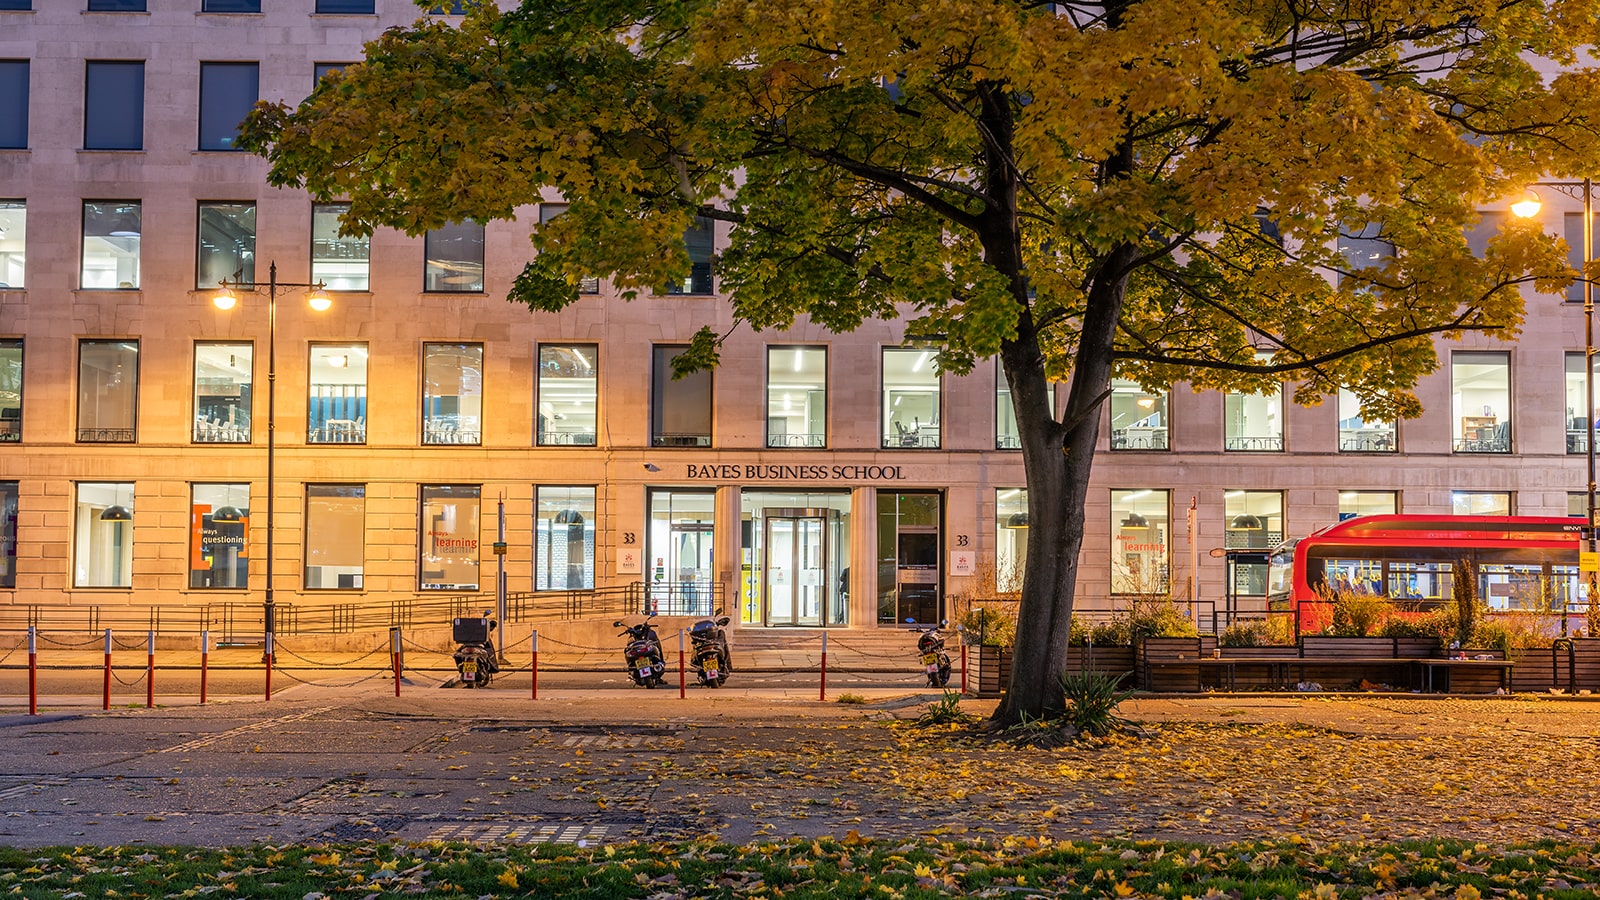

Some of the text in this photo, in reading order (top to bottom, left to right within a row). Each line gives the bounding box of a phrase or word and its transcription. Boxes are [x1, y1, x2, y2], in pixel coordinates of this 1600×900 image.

[687, 465, 906, 480] BAYES BUSINESS SCHOOL
[197, 528, 218, 538] Always
[623, 532, 636, 544] 33
[203, 535, 248, 545] questioning
[436, 537, 478, 549] learning
[956, 535, 969, 546] 33
[1124, 541, 1166, 554] learning
